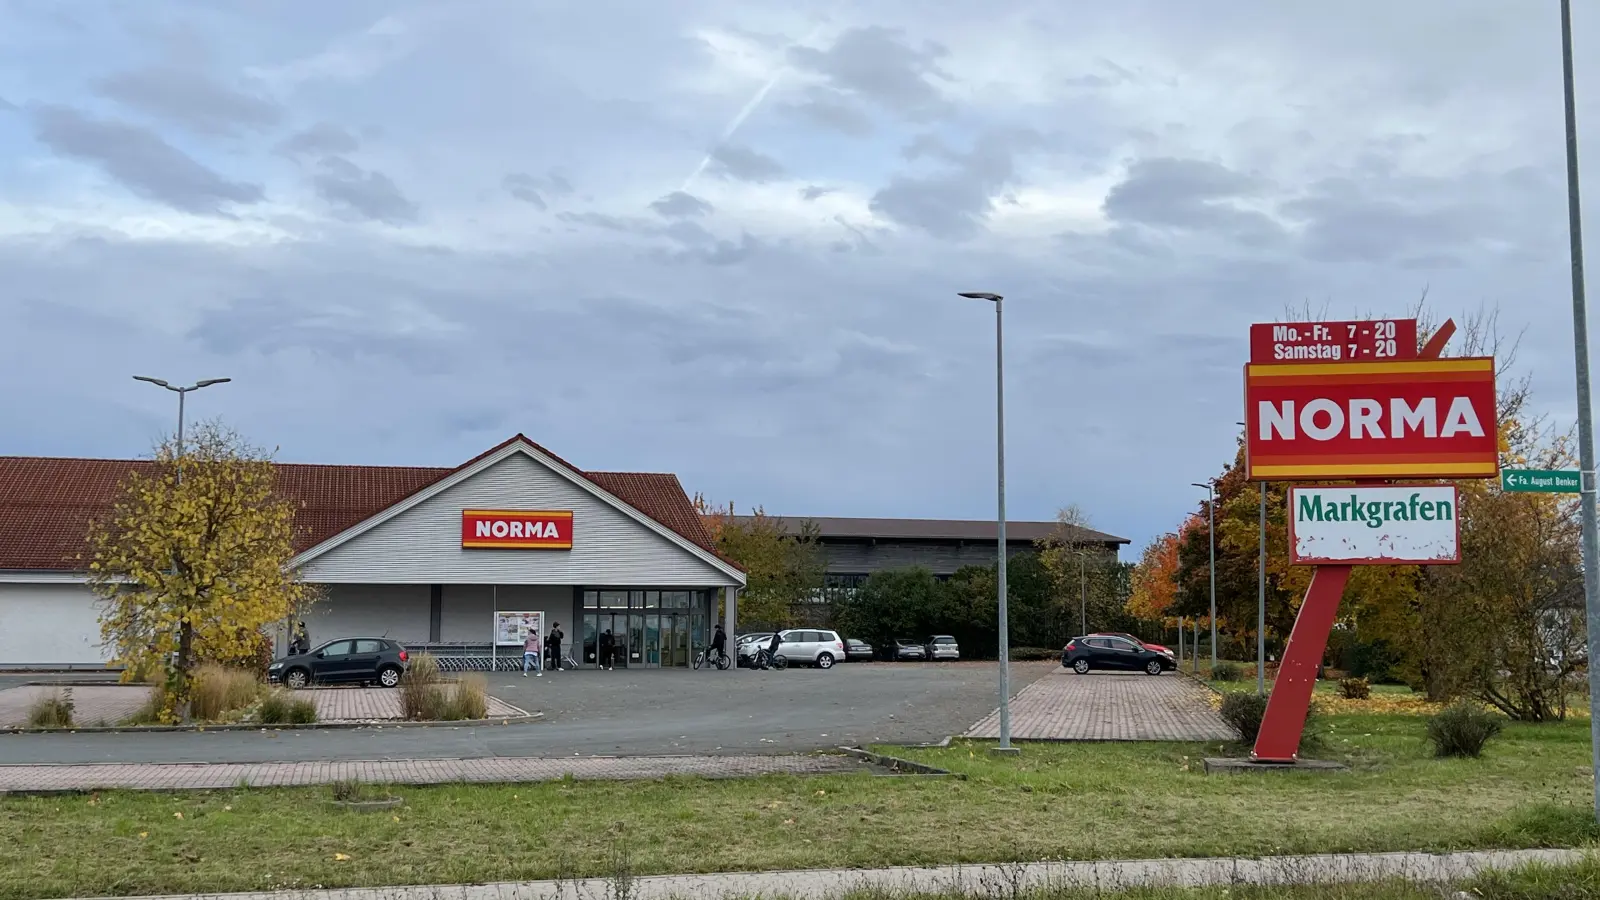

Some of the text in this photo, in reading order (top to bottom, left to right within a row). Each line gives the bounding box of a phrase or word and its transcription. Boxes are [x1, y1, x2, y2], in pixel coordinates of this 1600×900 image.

[1347, 325, 1357, 339] 7
[1374, 321, 1396, 340] 20
[1274, 343, 1341, 360] Samstag
[1348, 344, 1358, 358] 7
[1375, 340, 1397, 357] 20
[1259, 396, 1486, 441] NORMA
[1518, 475, 1578, 488] Fa. August Benker
[1298, 493, 1453, 528] Markgrafen
[475, 520, 560, 539] NORMA
